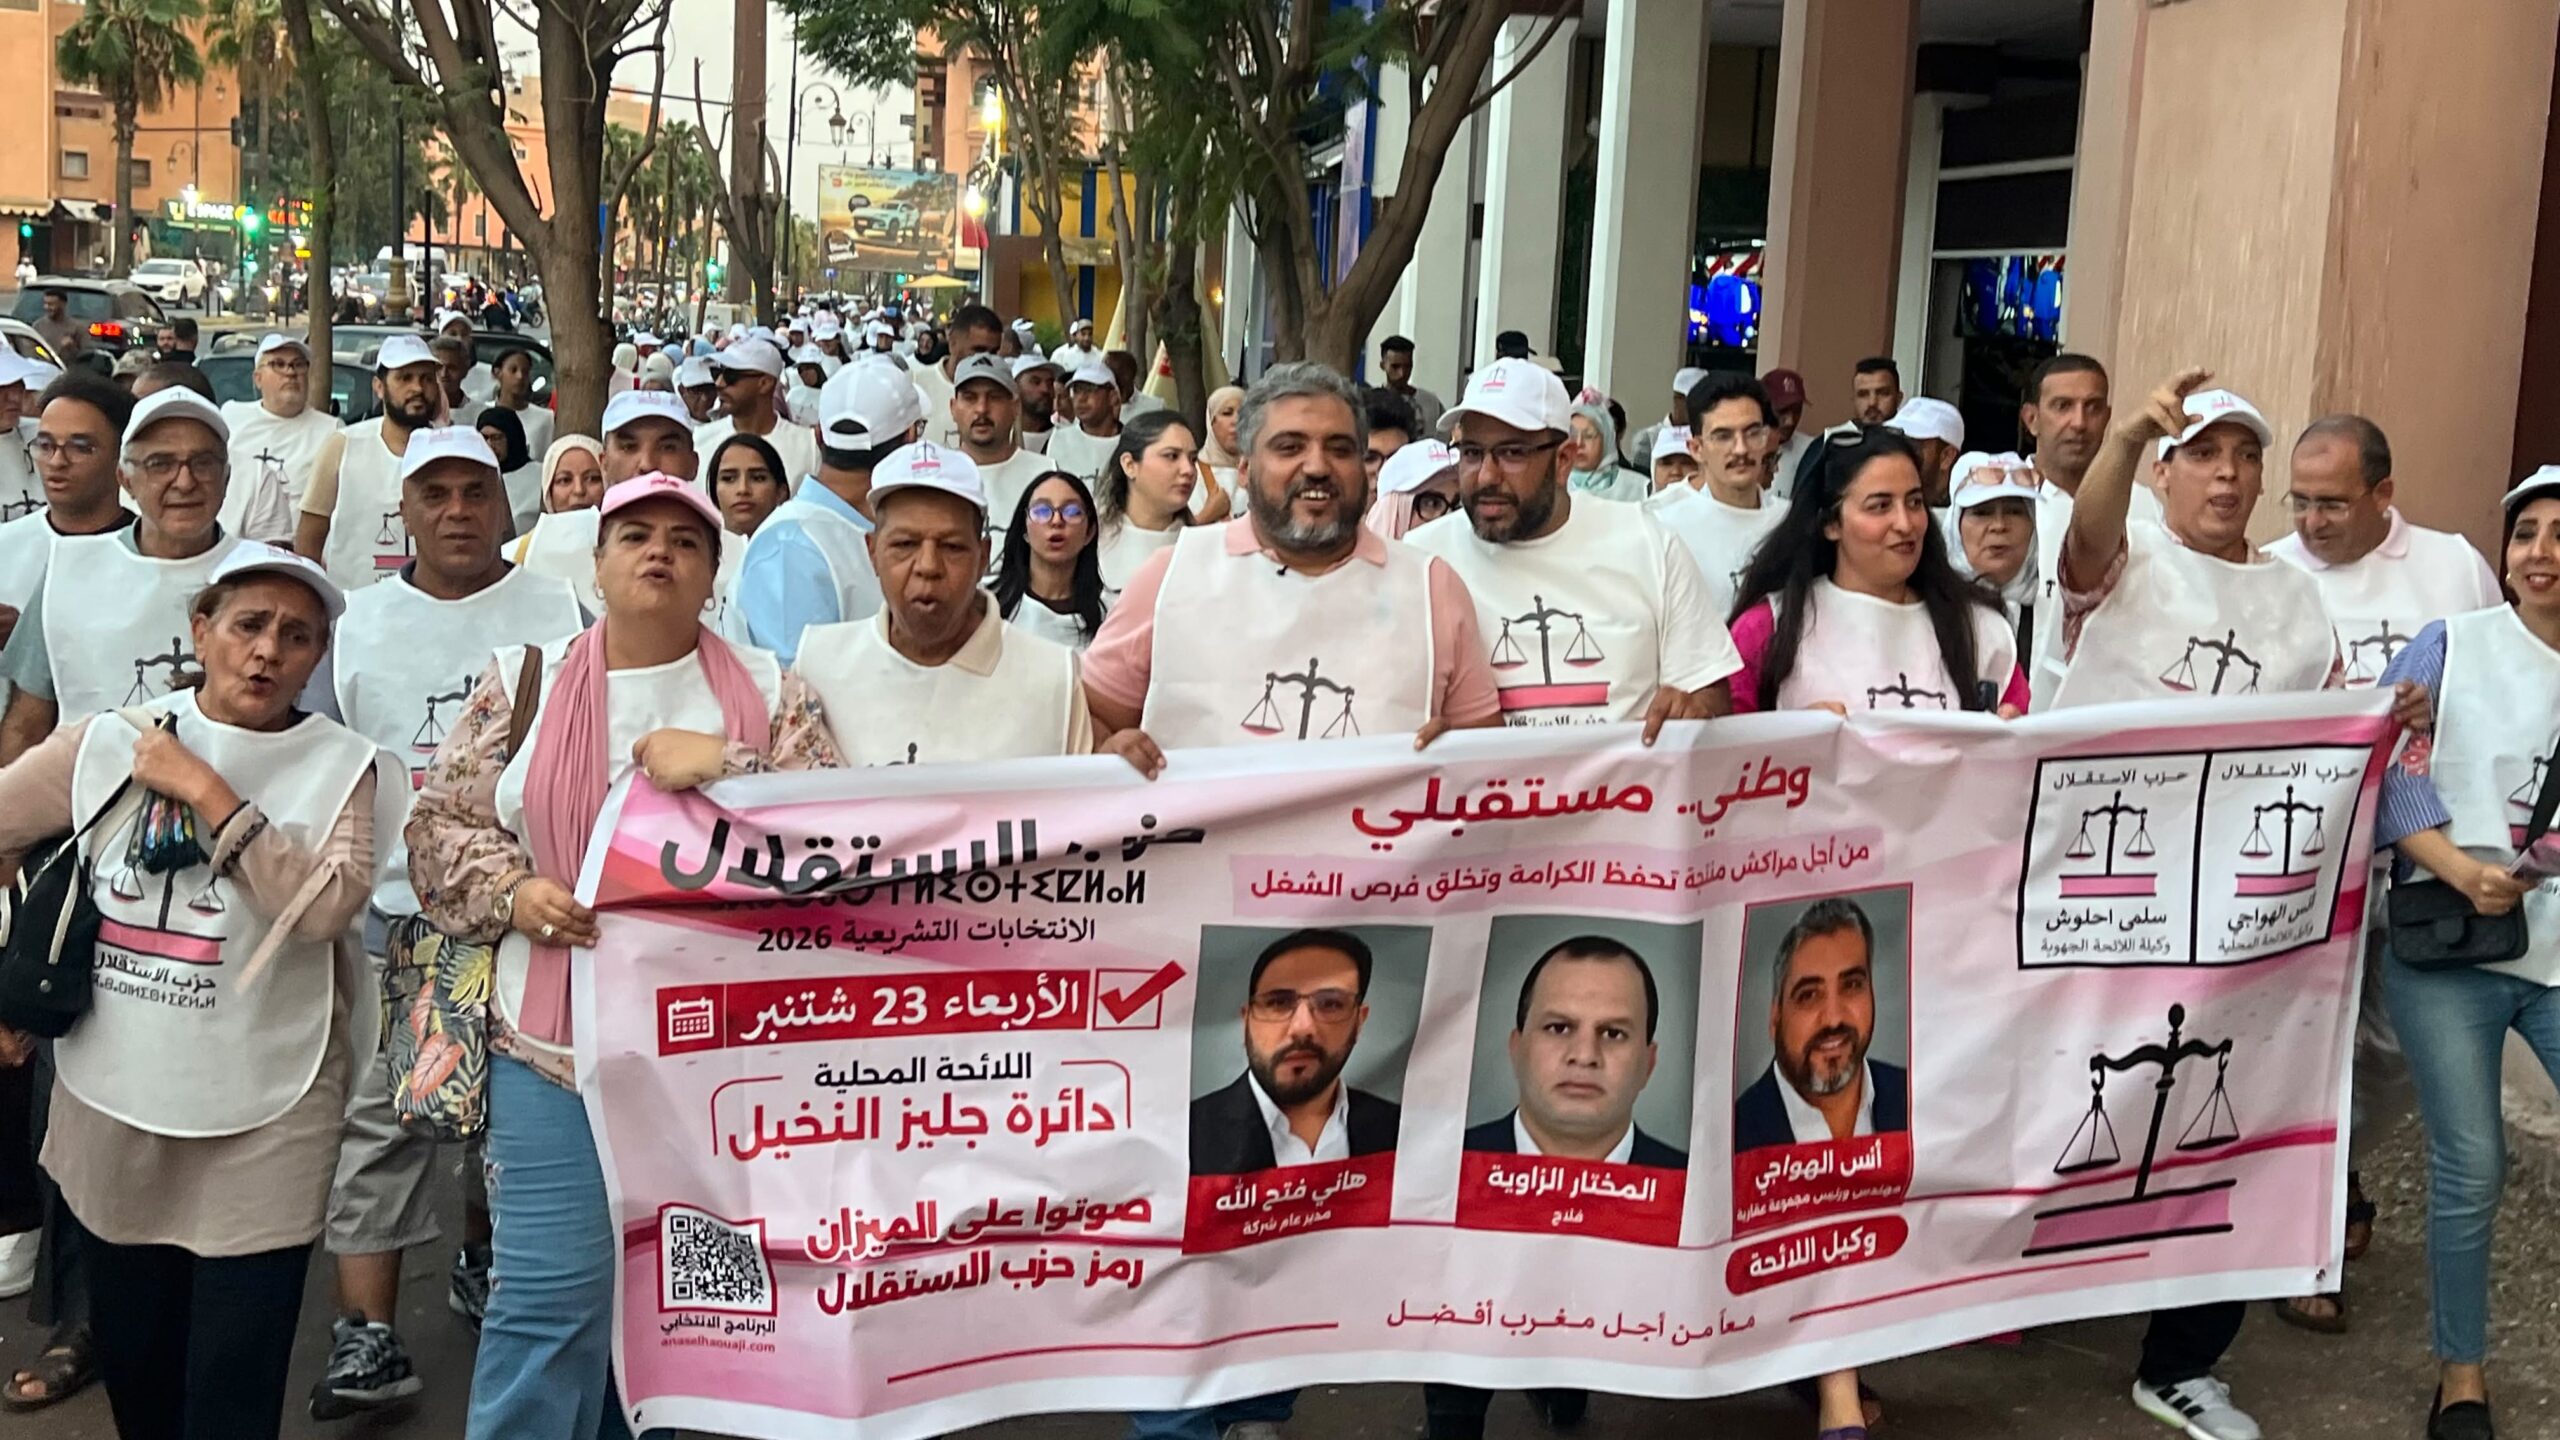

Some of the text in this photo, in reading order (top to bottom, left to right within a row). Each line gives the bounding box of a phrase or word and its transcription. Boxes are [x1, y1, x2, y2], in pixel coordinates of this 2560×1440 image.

[2053, 768, 2189, 790] حزب الاستقلال
[2221, 762, 2360, 786] حزب الاستقلال
[1352, 775, 1654, 851] مستقبلي
[1730, 849, 1799, 885] مراكش
[1801, 836, 1835, 873] أجل
[1838, 842, 1870, 869] من
[1251, 868, 1343, 900] الشغل
[1350, 872, 1420, 903] فرص
[1426, 862, 1502, 901] وتخلق
[1508, 859, 1594, 889] الكرامة
[1601, 858, 1678, 892] تحفظ
[757, 916, 1095, 955] الانتخابات التشريعية 2026
[2045, 907, 2168, 932] سلمى احلوش
[2228, 903, 2287, 936] الهواجي
[2092, 938, 2136, 954] اللائحة
[2139, 938, 2171, 955] وكيلة
[93, 951, 216, 993] حزب الاستقلال
[740, 973, 1079, 1041] الأربعاء 23 شتنبر
[815, 1052, 1031, 1088] اللائحة المحلية
[728, 1088, 1115, 1162] دائرة جليز النخيل
[1755, 1138, 1881, 1195] أنس الهواجي
[1215, 1169, 1368, 1213] هاني فتح الله
[1487, 1163, 1656, 1204] المختار الزاوية
[1551, 1207, 1585, 1226] فلاح
[1736, 1202, 1767, 1222] عقارية
[1768, 1193, 1811, 1213] مجموعة
[807, 1195, 1152, 1263] صوتوا على الميزان
[1242, 1206, 1332, 1237] مدير عام شركة
[1750, 1225, 1877, 1278] وكيل اللائحة
[818, 1252, 1145, 1317] رمز حزب الاستقلال
[660, 1312, 776, 1337] البرنامج الانتخابي
[1386, 1299, 1493, 1328] أفضل
[1500, 1306, 1595, 1334] مغرب
[1603, 1307, 1665, 1339] أجل
[661, 1335, 776, 1353] anaselhaouaji.com
[1672, 1321, 1714, 1347] من
